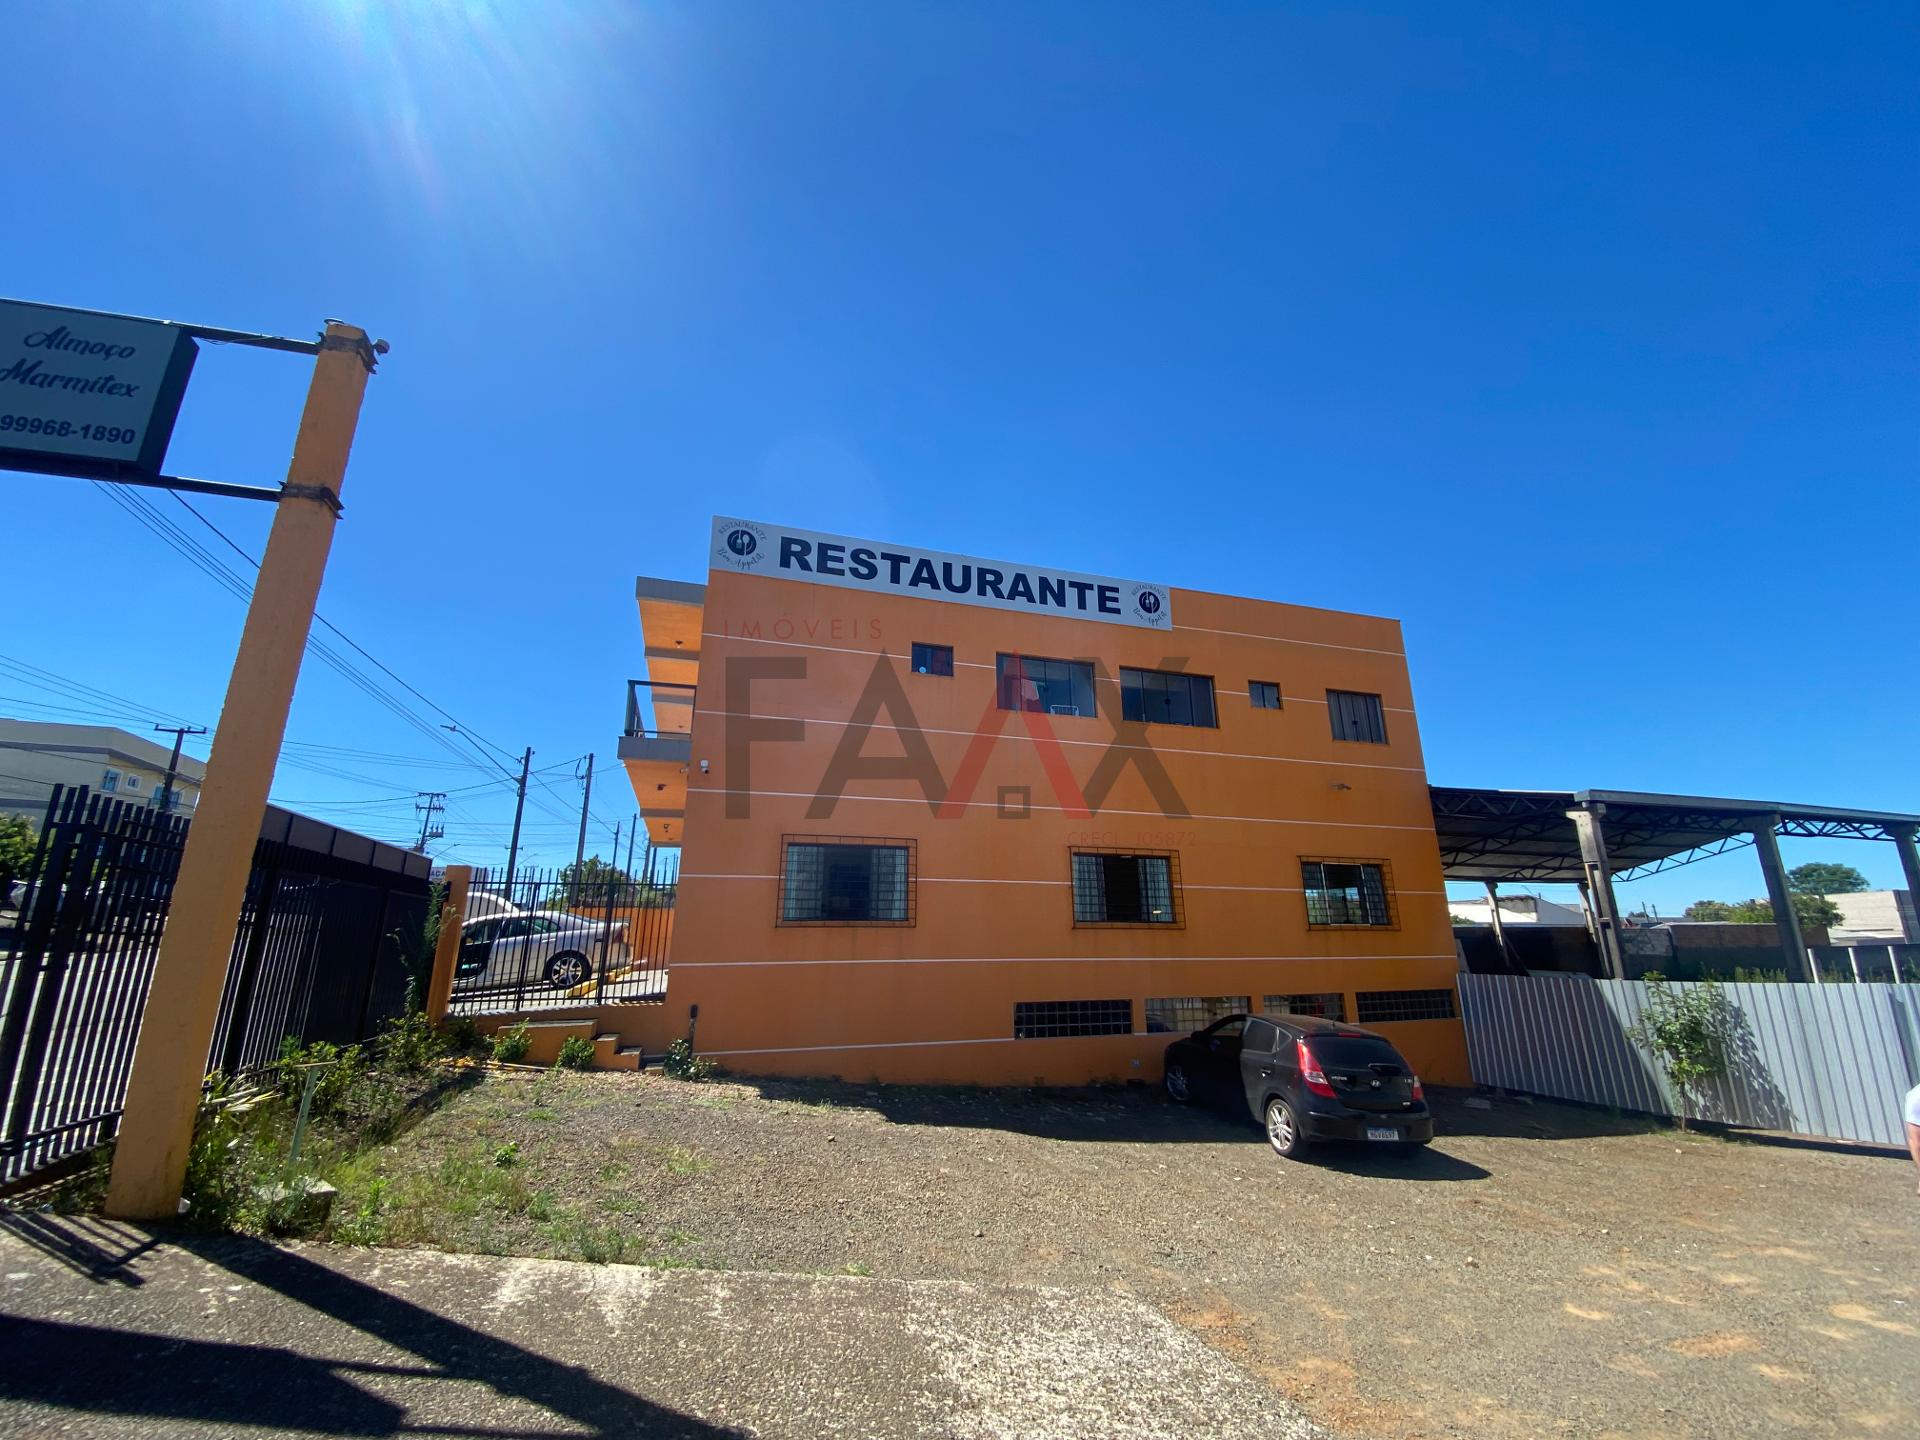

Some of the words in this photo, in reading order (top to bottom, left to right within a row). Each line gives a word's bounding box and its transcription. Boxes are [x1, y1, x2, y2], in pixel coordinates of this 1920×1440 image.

[23, 325, 137, 360] Almoço
[0, 357, 141, 398] Marmitex
[0, 414, 136, 445] 99968-1890
[779, 535, 1122, 616] RESTAURANTE
